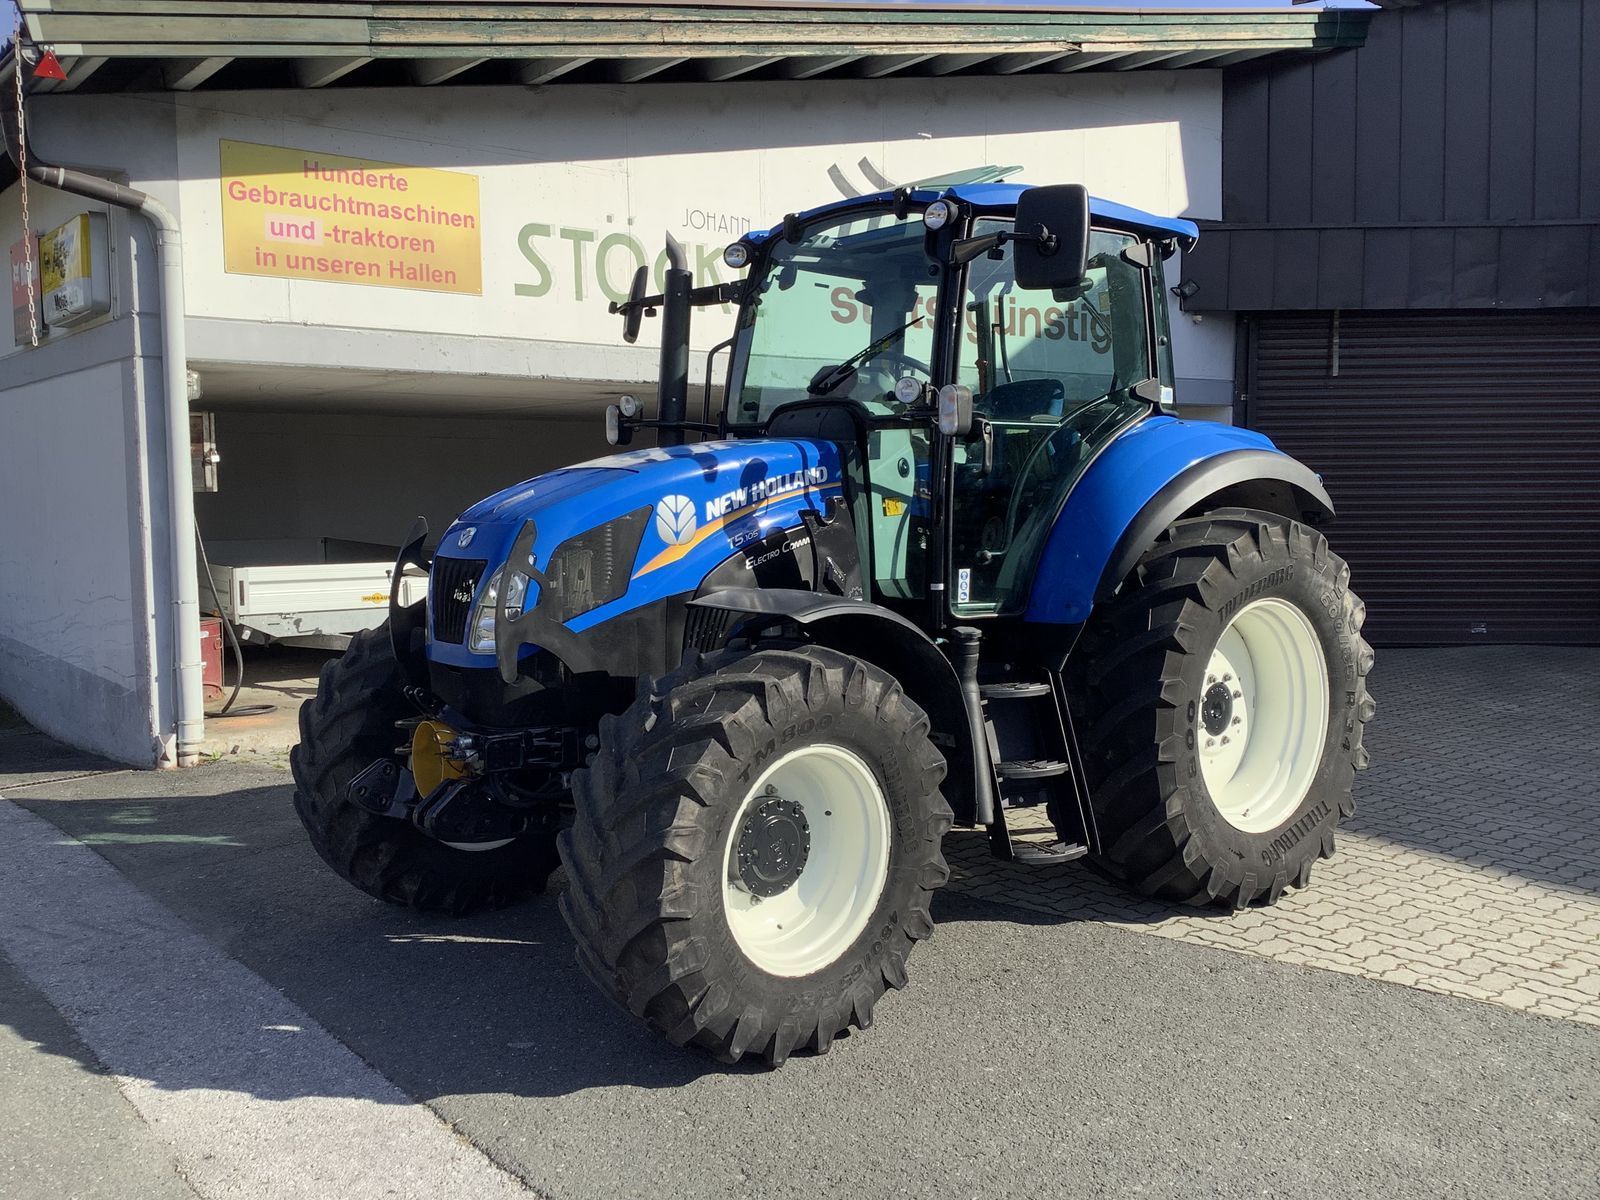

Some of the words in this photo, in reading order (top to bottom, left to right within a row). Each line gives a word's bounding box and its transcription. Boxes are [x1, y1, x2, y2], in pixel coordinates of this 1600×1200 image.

[303, 159, 409, 192] Hunderte
[228, 180, 475, 229] Gebrauchtmaschinen
[682, 208, 751, 235] JOHANN
[270, 220, 316, 241] und
[324, 224, 435, 254] -traktoren
[255, 246, 277, 268] in
[286, 254, 381, 278] unseren
[389, 259, 456, 285] Hallen
[705, 486, 748, 522] NEW
[749, 466, 828, 502] HOLLAND
[727, 529, 759, 550] T5.105
[736, 737, 776, 784] TM
[780, 713, 834, 744] 800
[1260, 799, 1332, 868] TRELLEBORG
